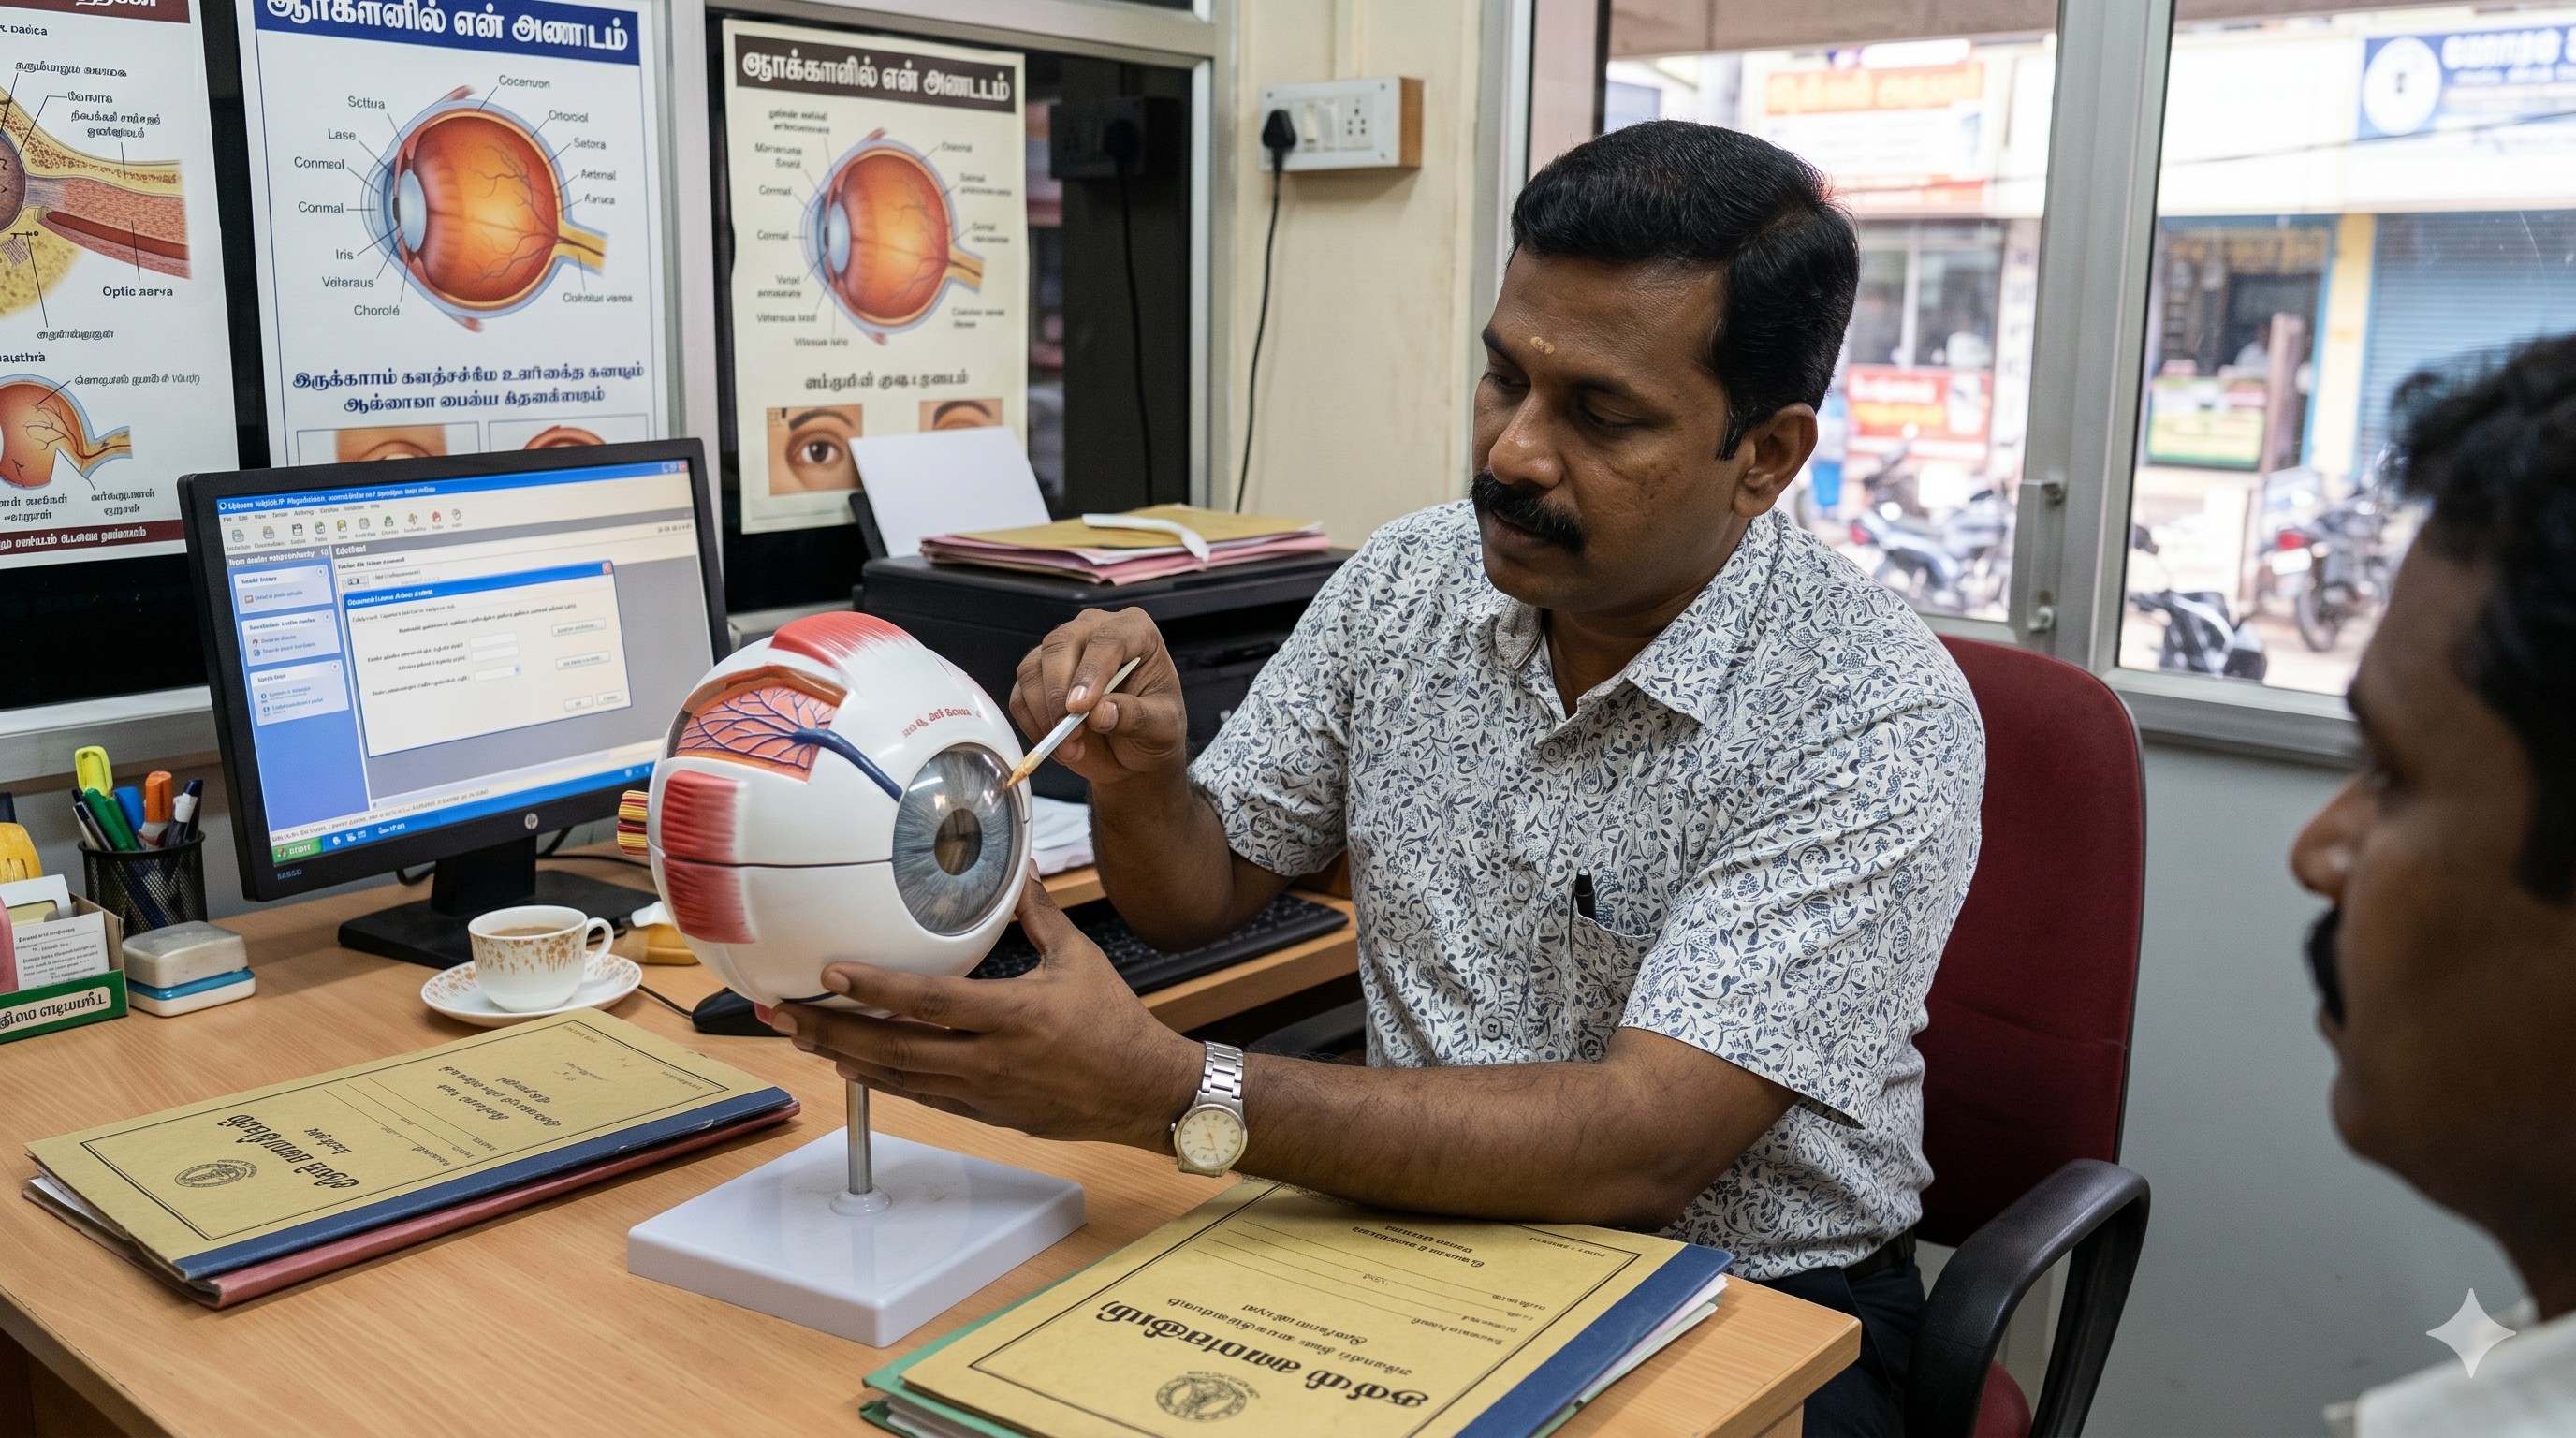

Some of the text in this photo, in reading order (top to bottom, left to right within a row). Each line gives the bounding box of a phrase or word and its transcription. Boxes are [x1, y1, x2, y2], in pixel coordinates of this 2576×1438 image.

[454, 3, 505, 38] என்
[328, 128, 357, 140] Lase
[298, 201, 344, 213] Conmal
[336, 249, 354, 260] Iris
[102, 286, 137, 299] Optic
